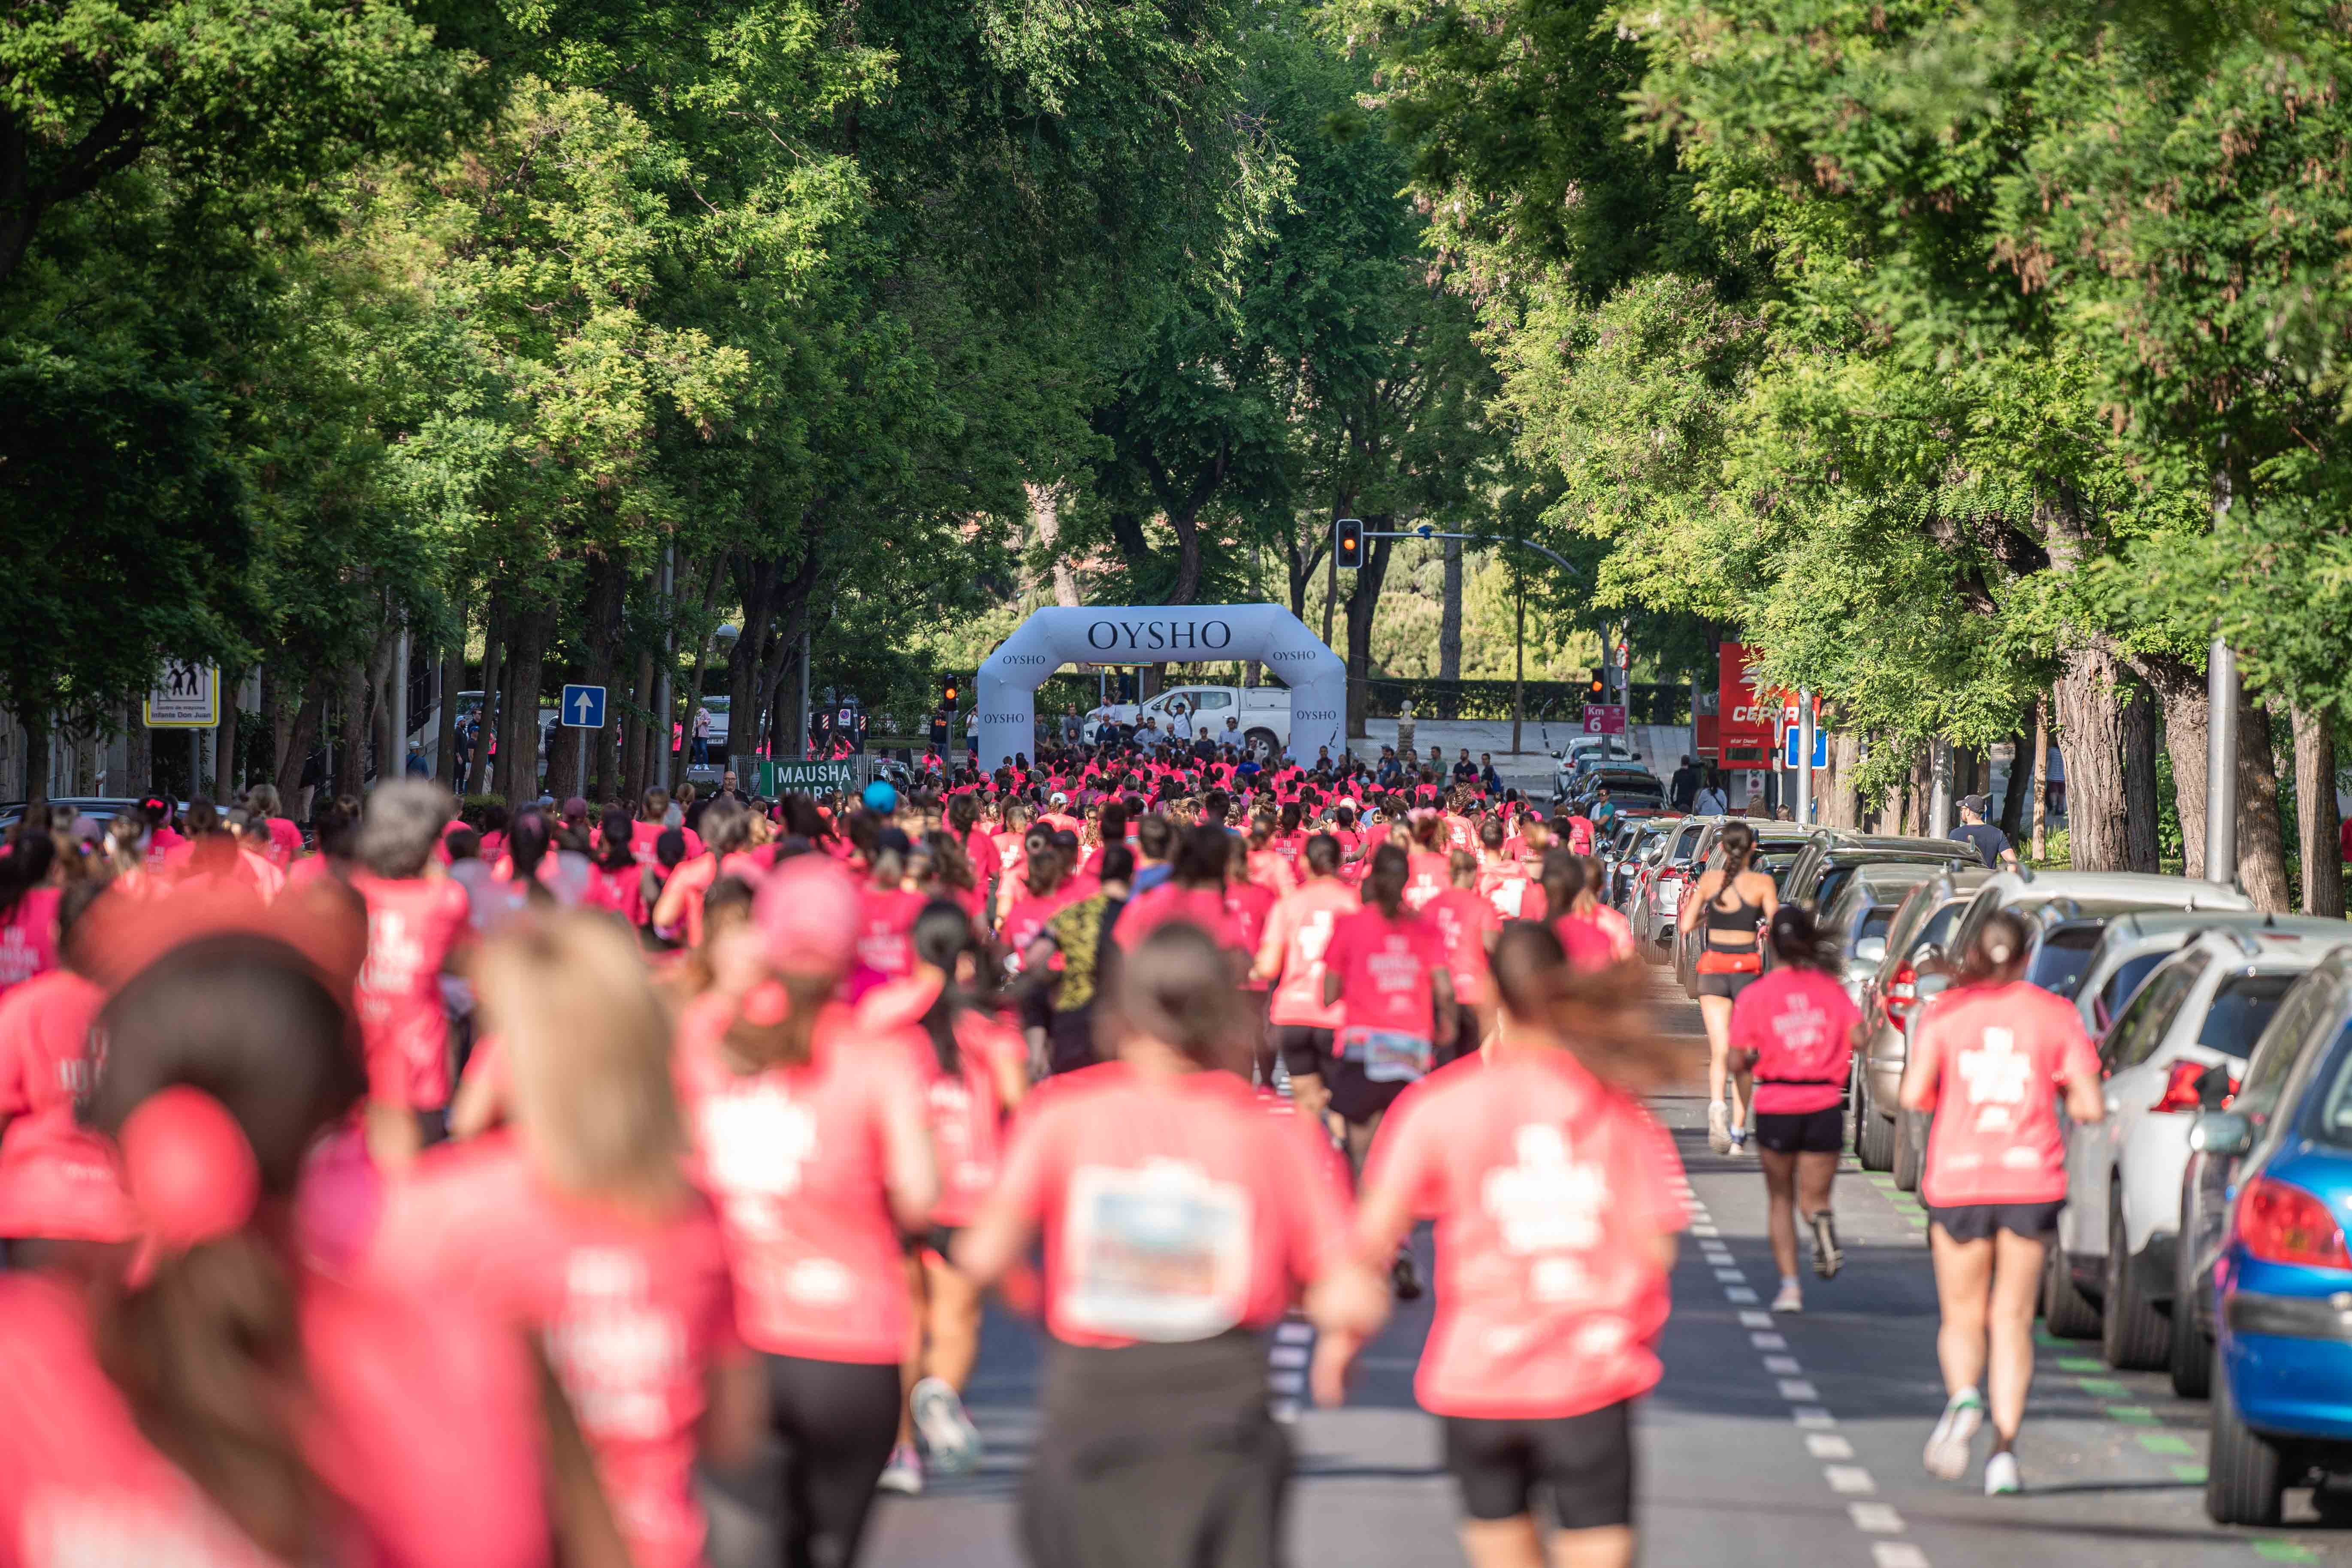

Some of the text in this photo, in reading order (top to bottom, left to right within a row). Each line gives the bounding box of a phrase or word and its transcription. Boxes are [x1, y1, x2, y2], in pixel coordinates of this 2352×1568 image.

[1088, 621, 1231, 649] OYSHO
[1003, 655, 1046, 665] OYSHO
[1273, 650, 1315, 661] OYSHO
[1297, 710, 1336, 720] OYSHO
[1588, 707, 1604, 715] Km
[984, 713, 1024, 724] OYSHO
[1590, 716, 1602, 732] 6
[778, 765, 851, 783] MAUSHA
